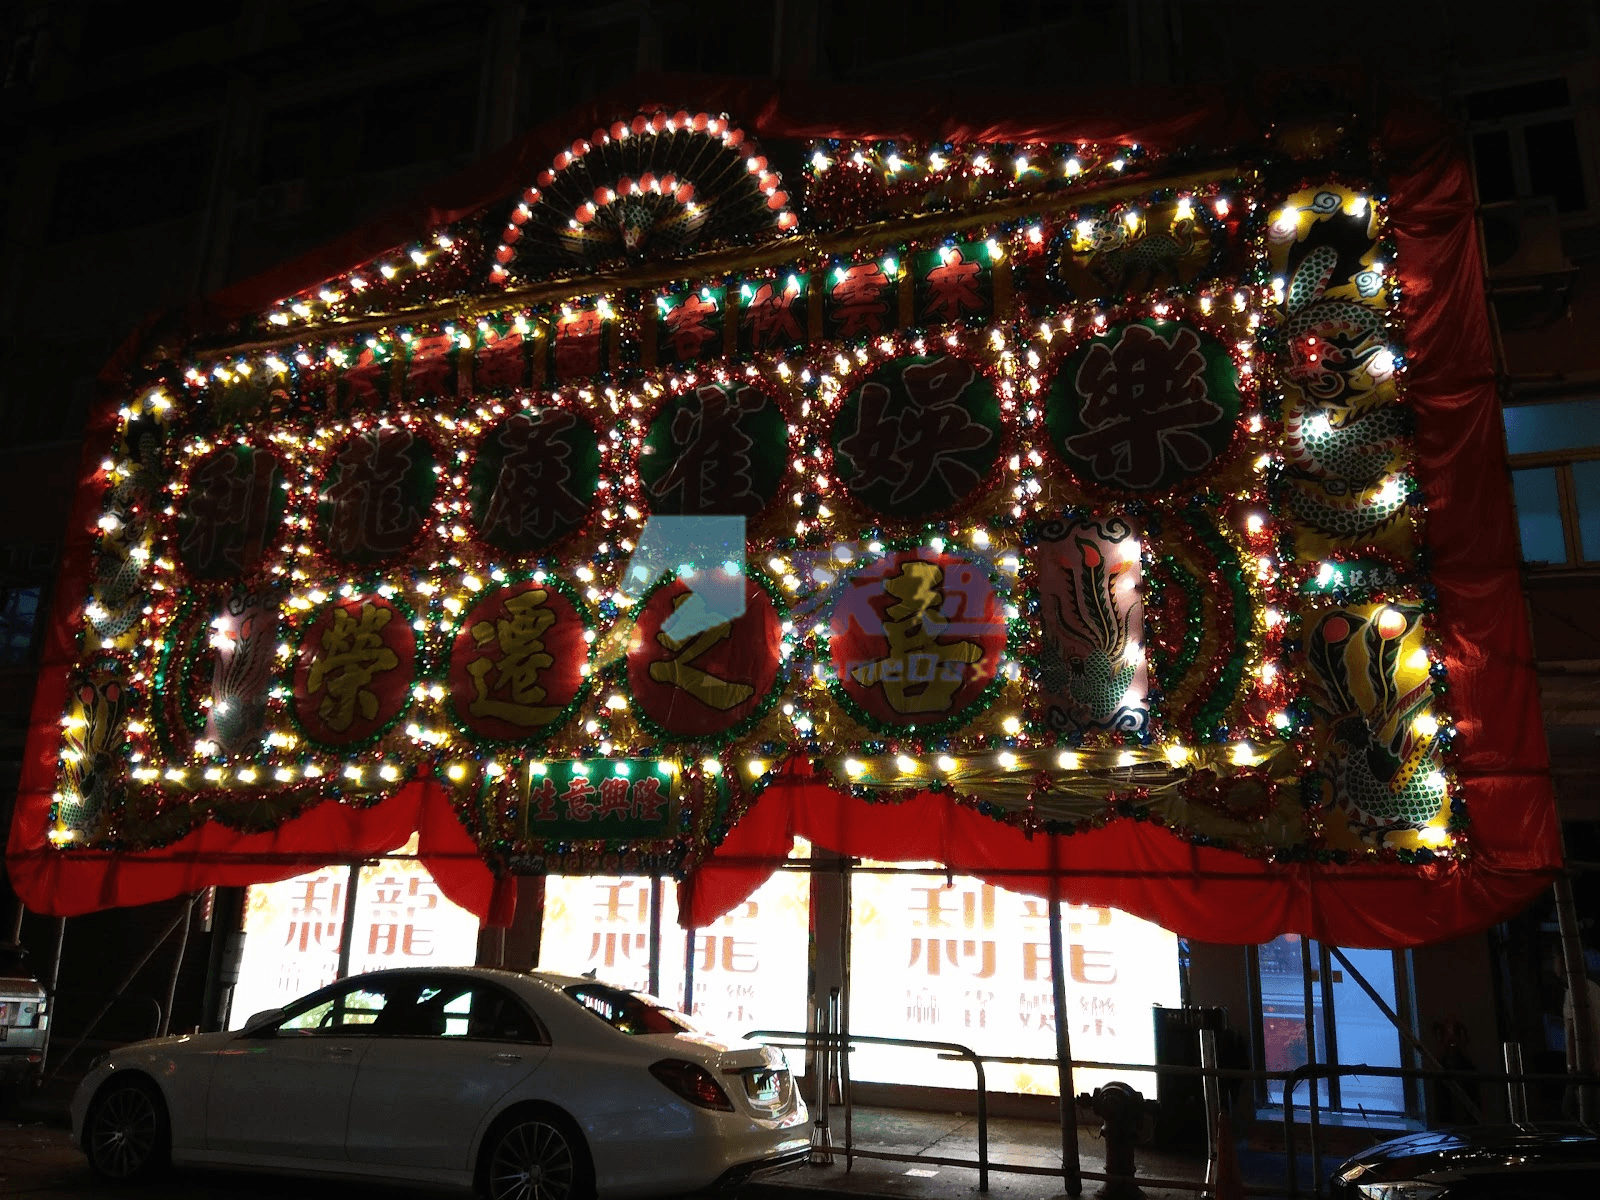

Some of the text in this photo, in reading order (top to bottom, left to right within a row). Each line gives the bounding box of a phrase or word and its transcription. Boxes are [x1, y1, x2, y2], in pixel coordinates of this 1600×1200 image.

[663, 248, 983, 360] 客似雲來
[182, 324, 1225, 569] 利龍麻雀娛樂
[530, 776, 669, 822] 生意興隆
